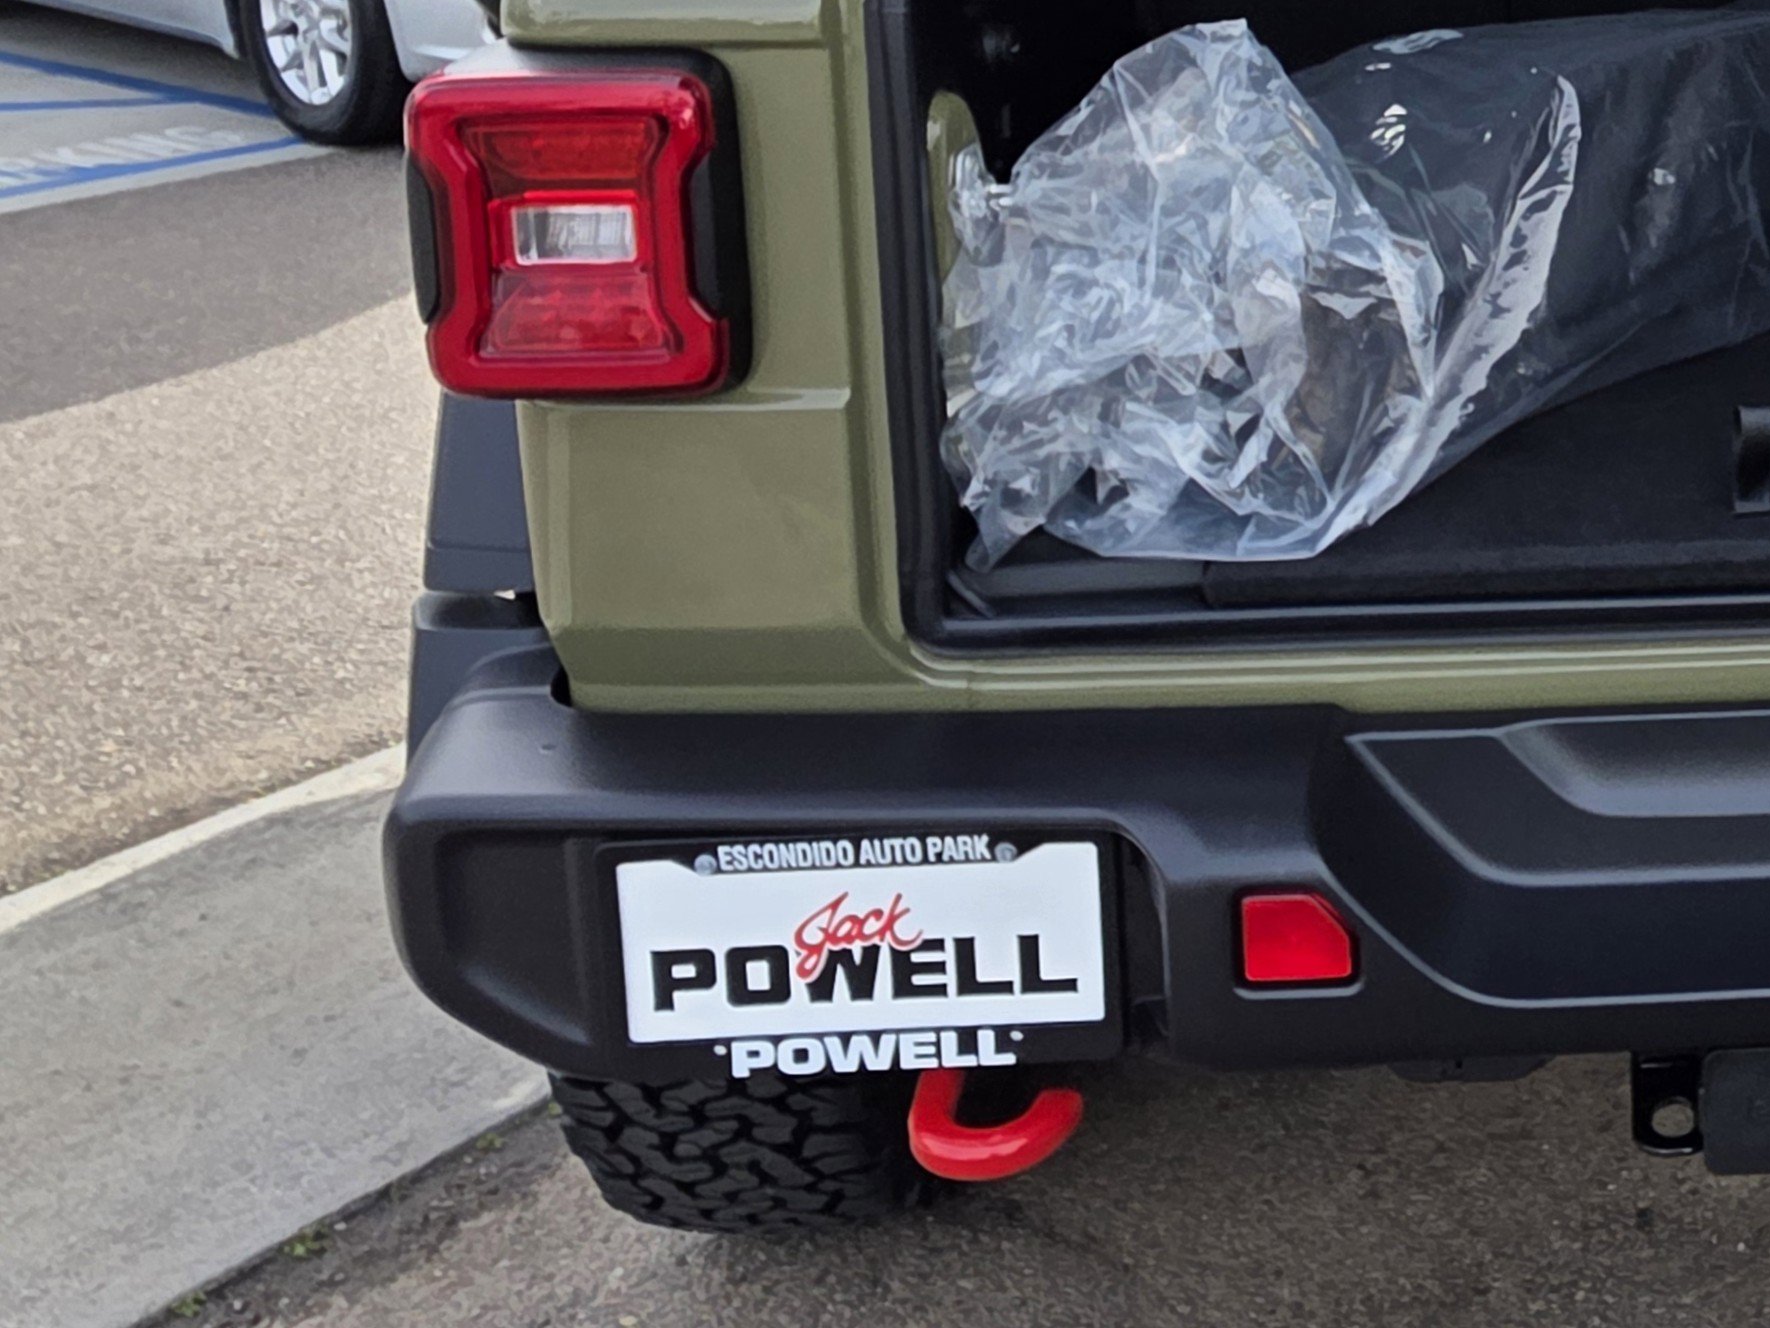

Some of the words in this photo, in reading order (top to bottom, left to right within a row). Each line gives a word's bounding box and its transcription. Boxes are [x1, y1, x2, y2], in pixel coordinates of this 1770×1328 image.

[717, 839, 854, 872] ESCONDIDO
[859, 836, 923, 866] AUTO
[926, 833, 992, 863] PARK
[793, 892, 924, 981] Jack
[649, 933, 1079, 1012] POWELL
[731, 1029, 1017, 1079] POWELL
